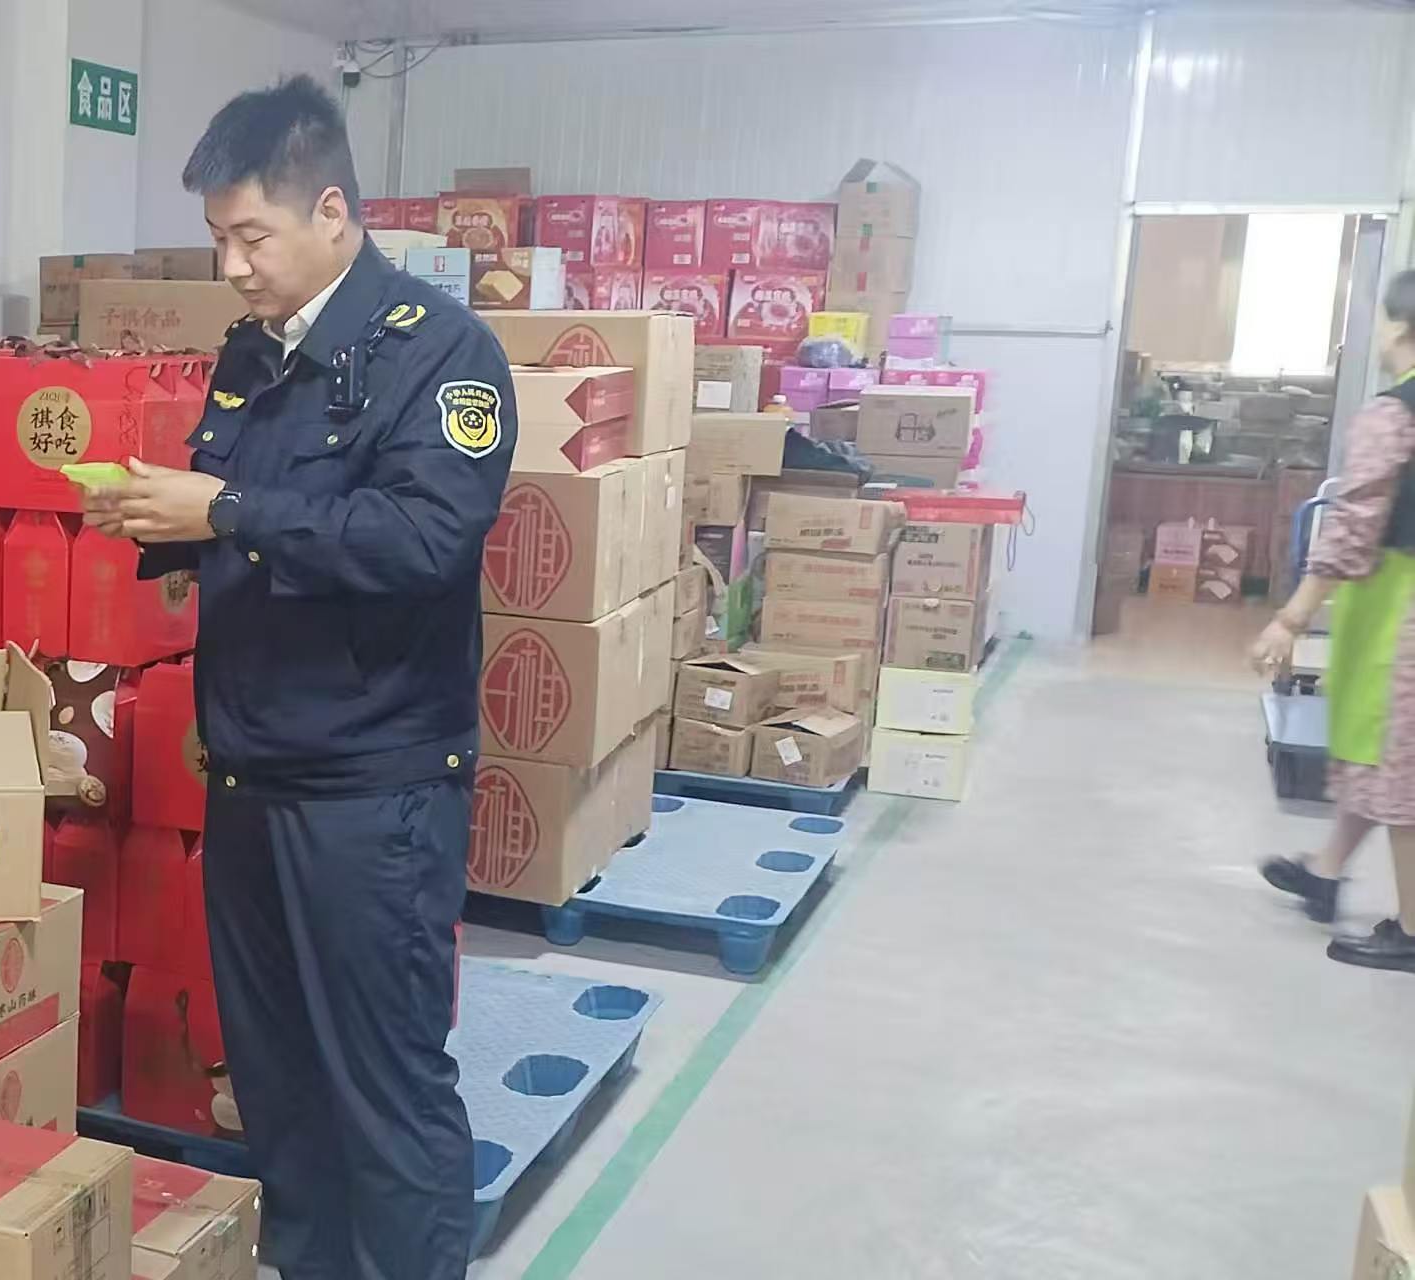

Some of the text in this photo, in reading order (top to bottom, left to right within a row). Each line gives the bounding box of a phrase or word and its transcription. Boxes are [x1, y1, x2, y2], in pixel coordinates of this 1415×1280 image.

[77, 70, 132, 124] 食品区
[30, 406, 80, 431] 祺食
[29, 431, 78, 456] 好吃
